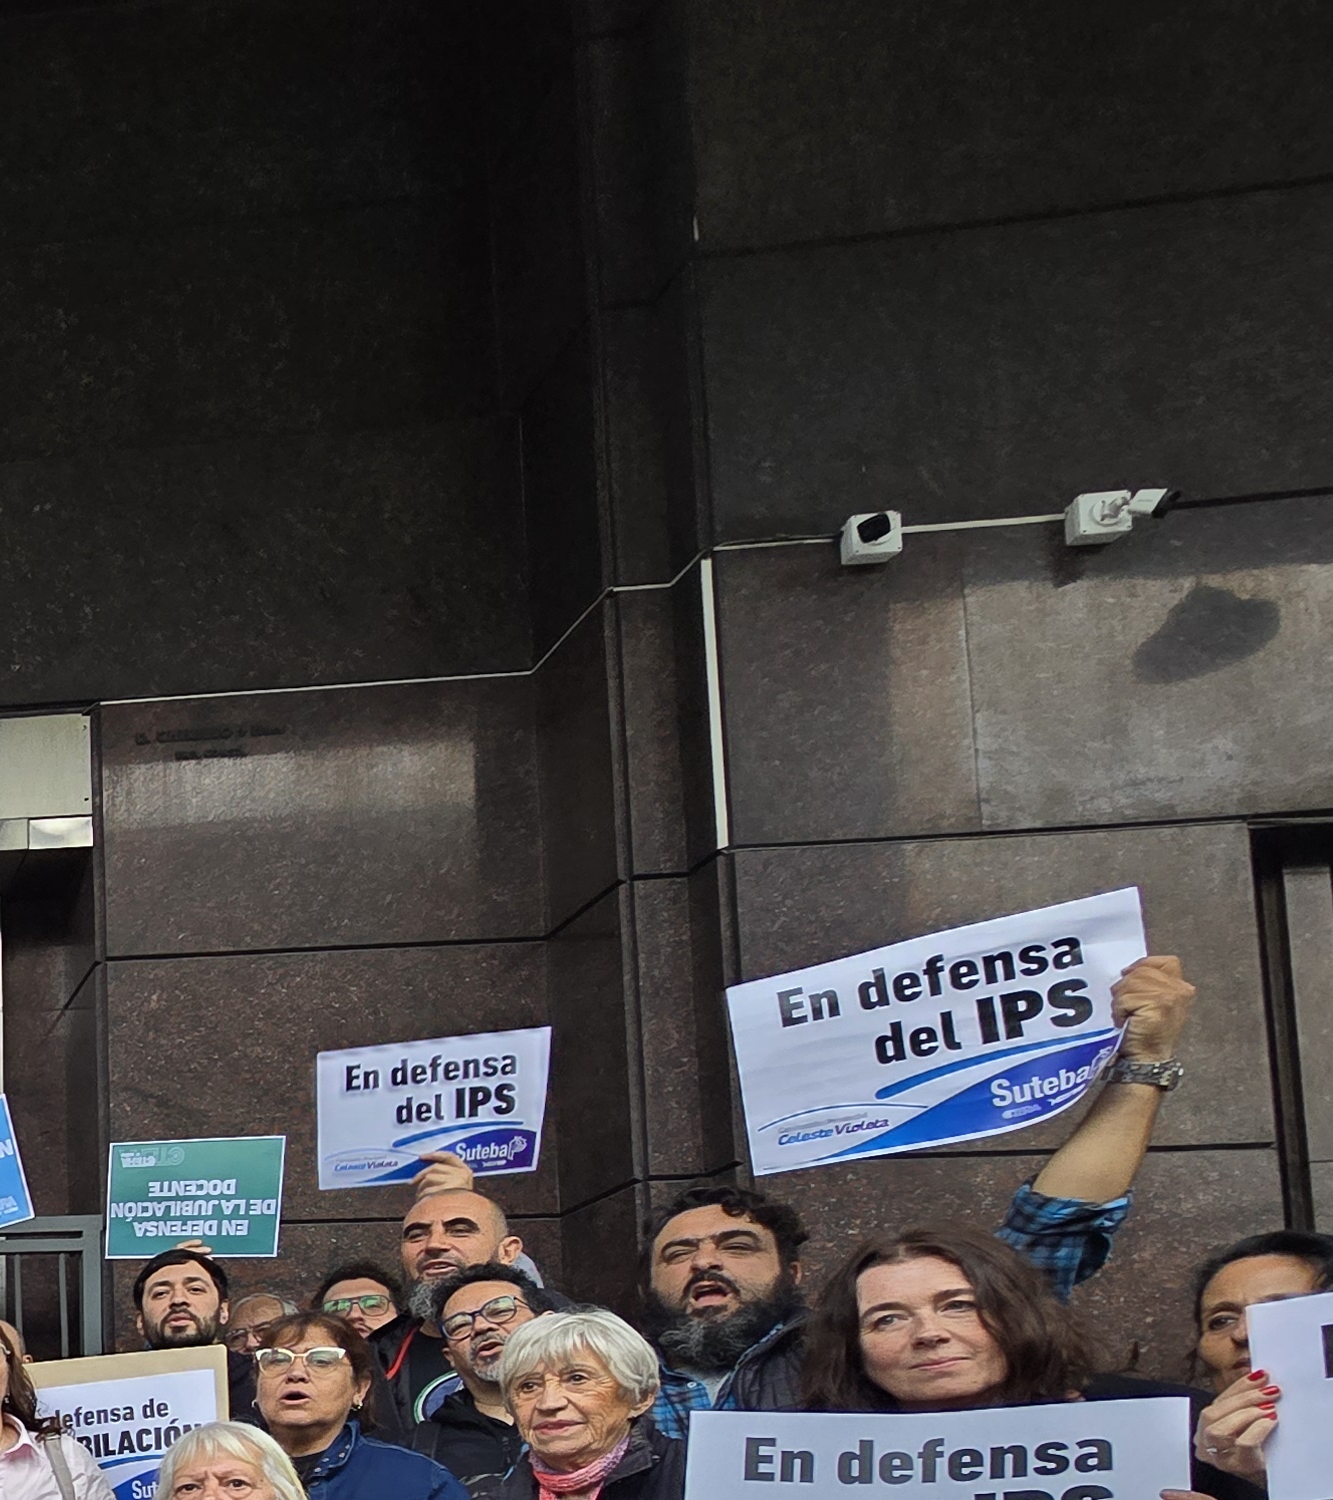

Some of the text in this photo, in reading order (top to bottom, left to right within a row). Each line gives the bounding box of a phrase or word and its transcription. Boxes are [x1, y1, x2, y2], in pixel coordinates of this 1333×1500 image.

[776, 935, 1084, 1029] En defensa
[874, 978, 1093, 1065] del IPS
[345, 1053, 517, 1093] En defensa
[990, 1065, 1088, 1109] Suteba
[395, 1081, 517, 1126] del IPS
[455, 1140, 508, 1162] Suteba
[148, 1178, 237, 1197] DOCENTE
[110, 1199, 276, 1222] DE LA JUBILACIÓN
[132, 1219, 249, 1238] EN DEFENSA
[142, 1397, 170, 1420] de
[744, 1437, 1114, 1485] En defensa
